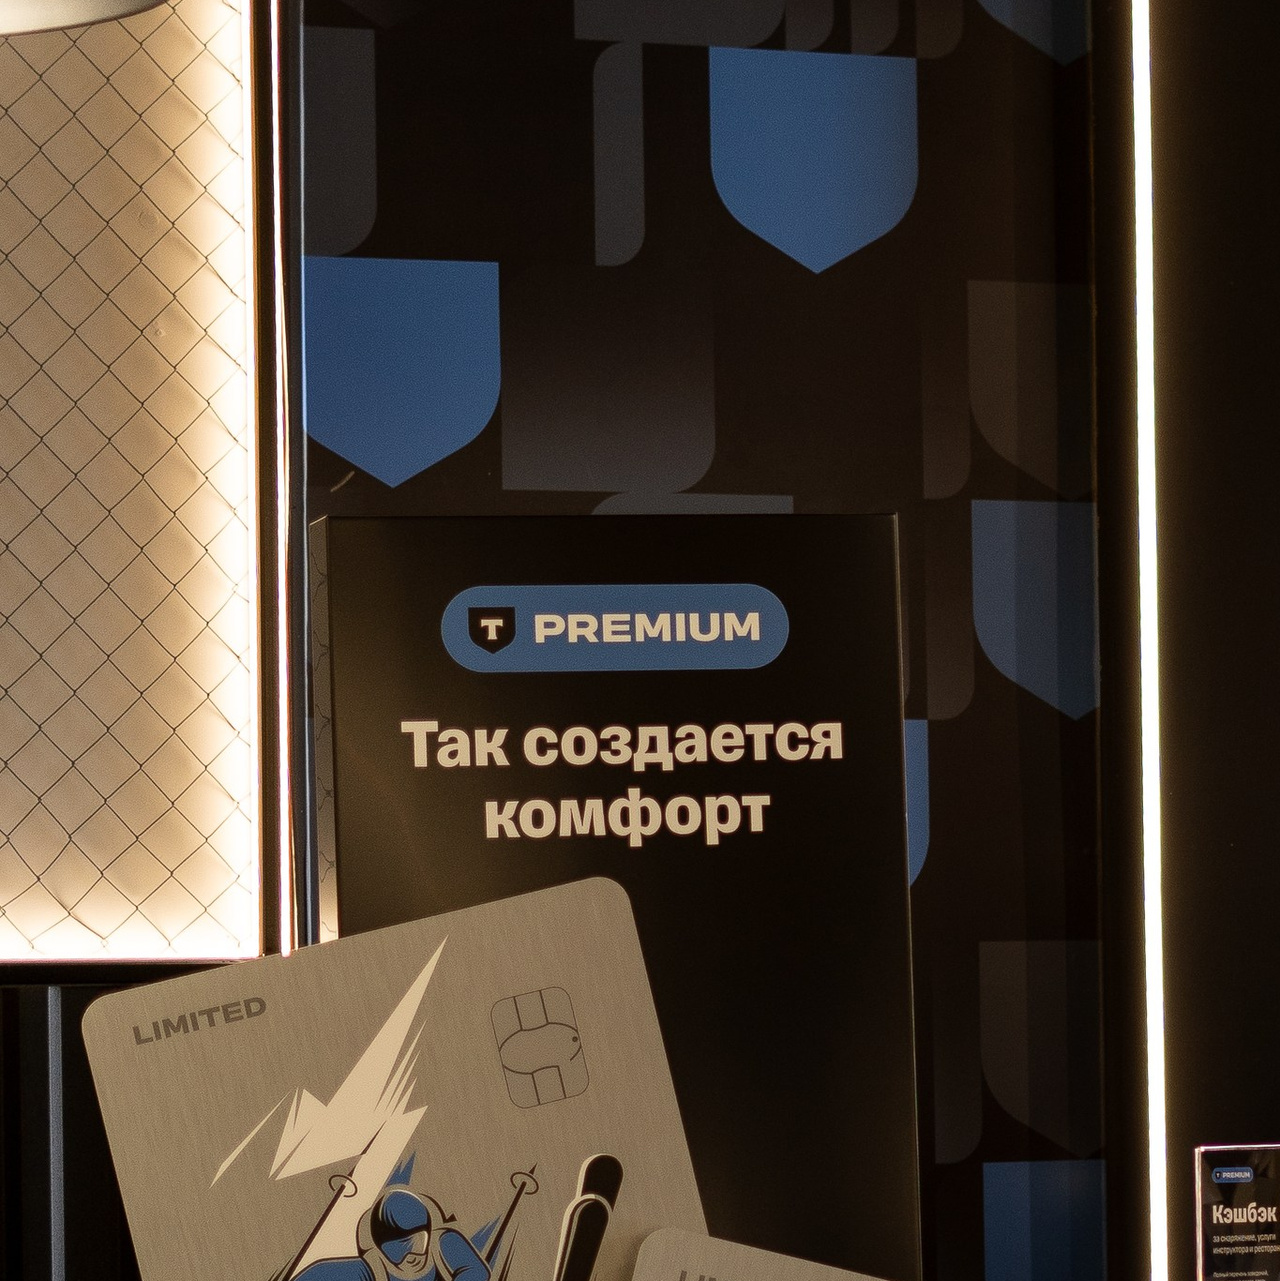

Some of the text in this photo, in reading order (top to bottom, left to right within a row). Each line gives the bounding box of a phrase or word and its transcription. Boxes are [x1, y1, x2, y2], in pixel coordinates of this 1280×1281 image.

[481, 612, 761, 643] T PREMIUM
[400, 721, 843, 771] Так создается
[484, 787, 771, 848] комфорт
[132, 997, 266, 1045] LIMITED
[1222, 1171, 1250, 1179] PREMIUM
[1212, 1202, 1277, 1224] Кэшбэк
